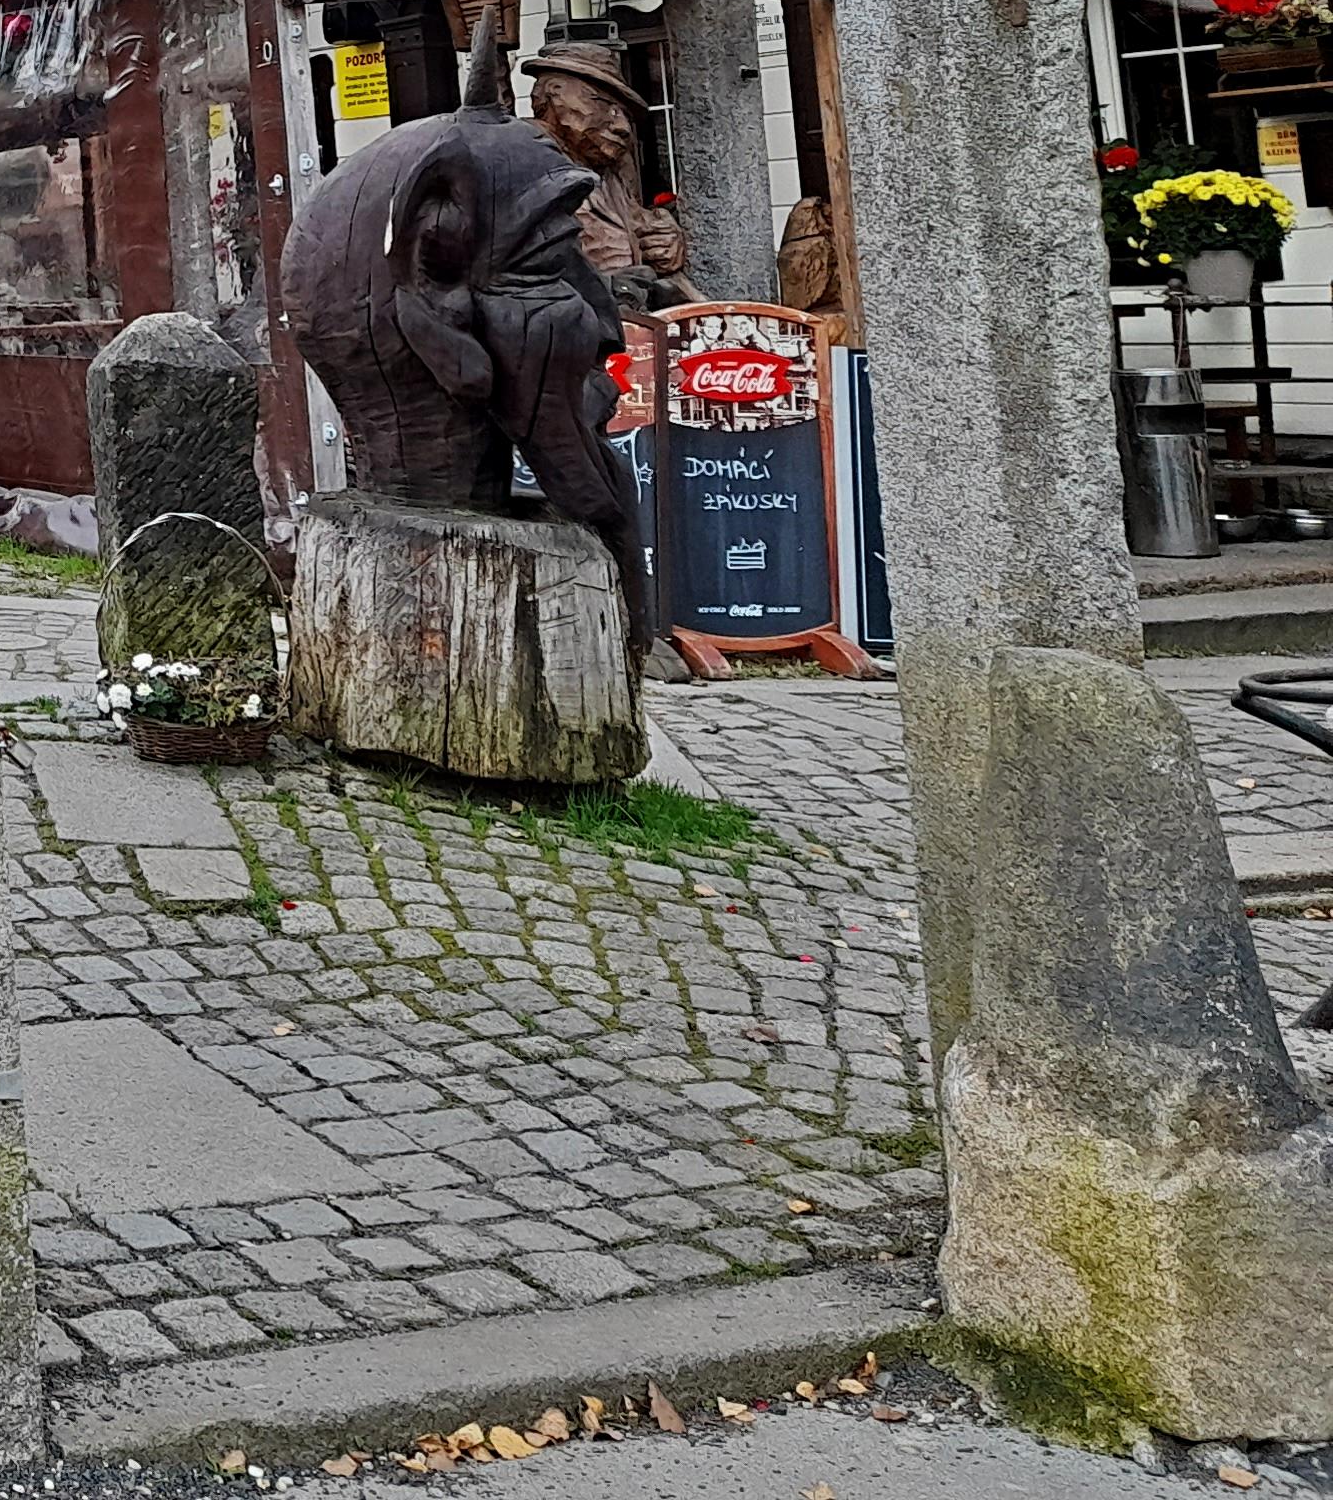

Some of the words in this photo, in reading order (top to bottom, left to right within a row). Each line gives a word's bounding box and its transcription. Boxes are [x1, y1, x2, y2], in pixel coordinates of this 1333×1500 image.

[692, 362, 778, 394] Coca-Cola
[683, 447, 774, 480] DOMÁCÍ
[702, 484, 798, 512] ZÁKUSKY
